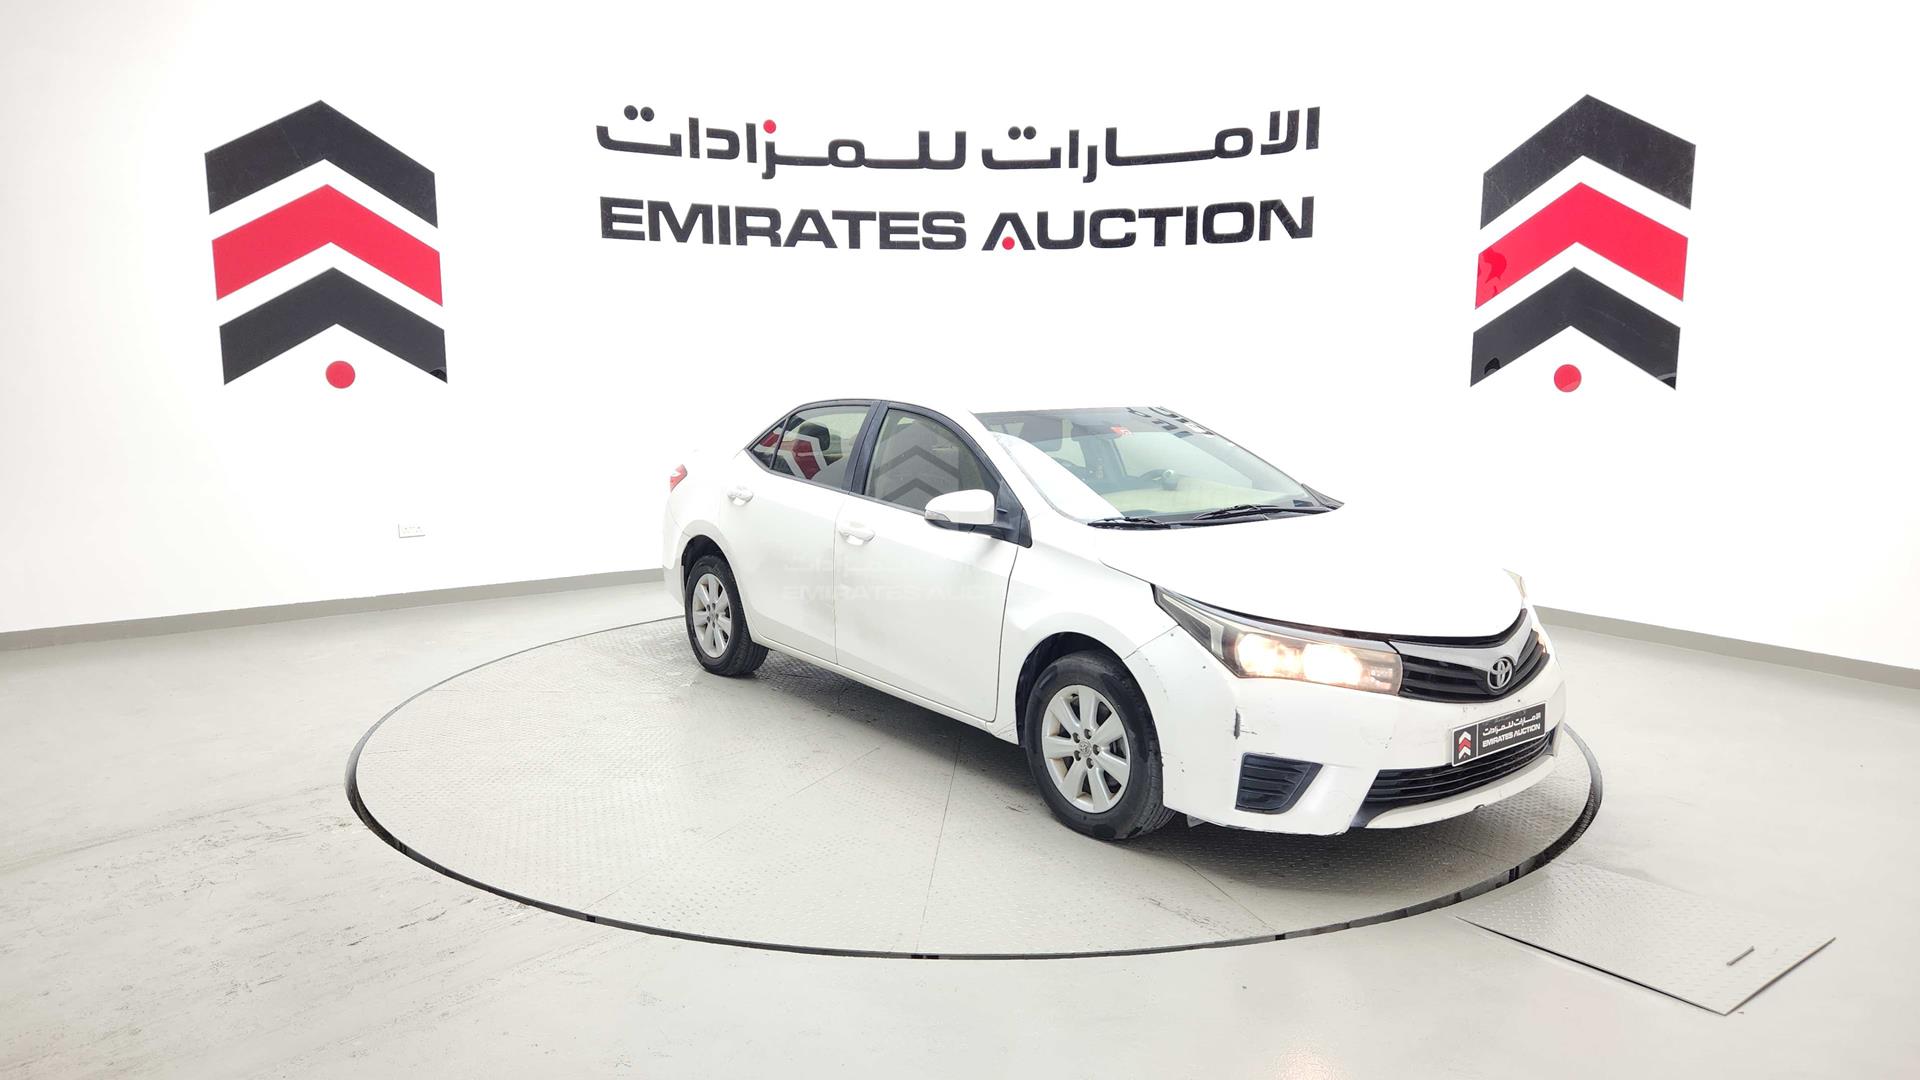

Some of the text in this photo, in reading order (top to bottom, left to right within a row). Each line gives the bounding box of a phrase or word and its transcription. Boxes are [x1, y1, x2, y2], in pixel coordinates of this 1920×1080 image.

[596, 105, 1321, 184] الامارات للمزادات
[599, 196, 1315, 251] EMIRATES AUCTION
[1482, 723, 1541, 748] EMIRATES AUCTION
